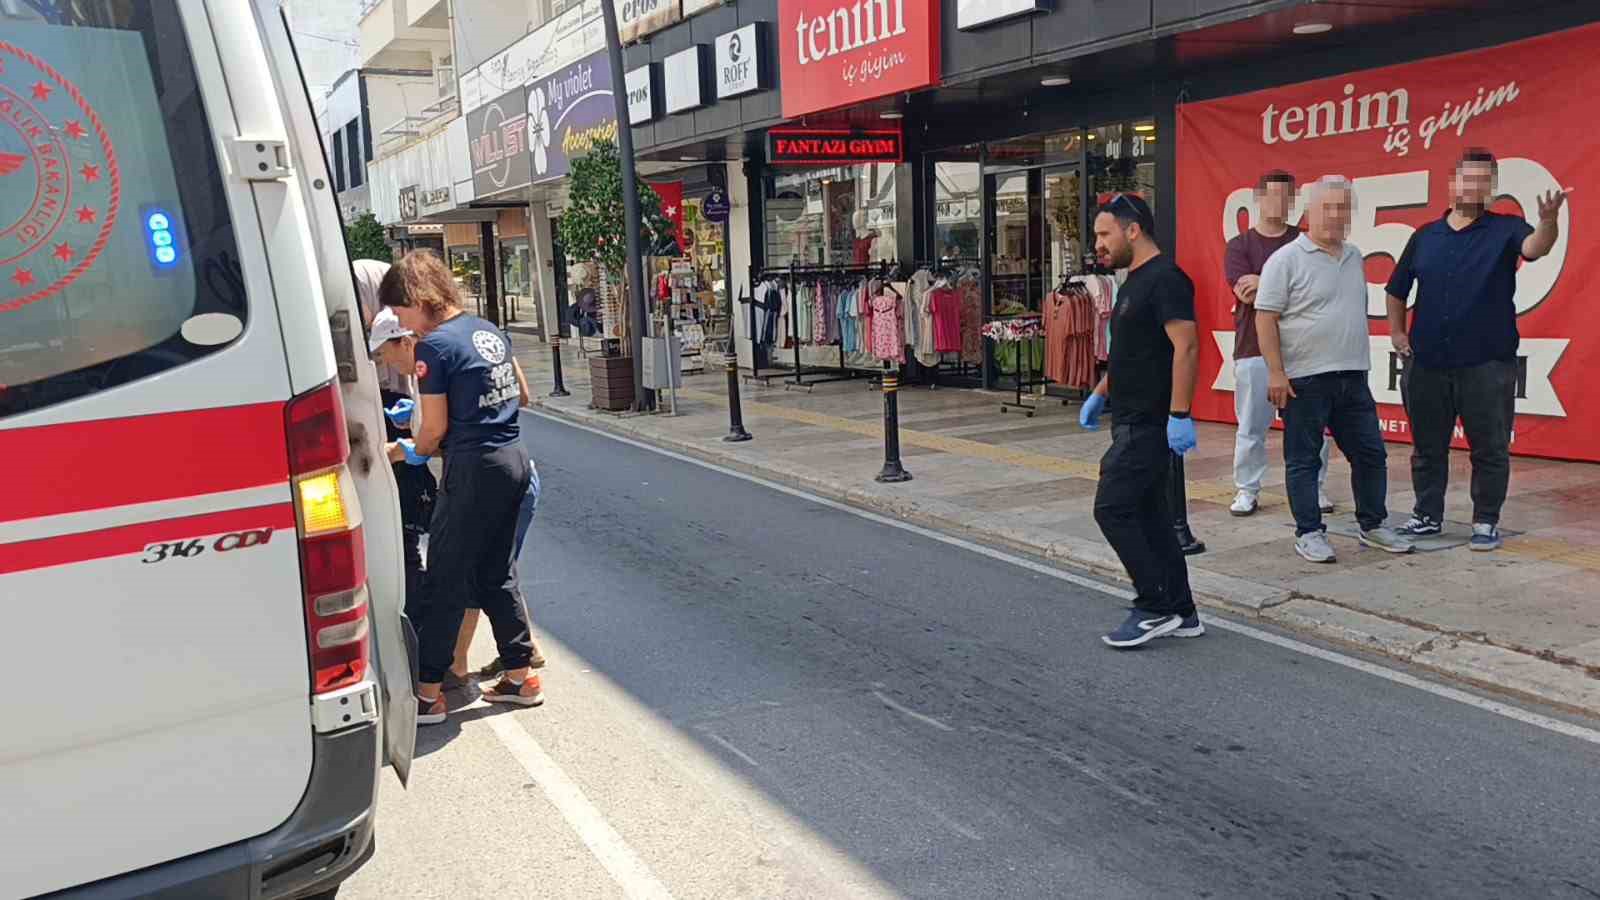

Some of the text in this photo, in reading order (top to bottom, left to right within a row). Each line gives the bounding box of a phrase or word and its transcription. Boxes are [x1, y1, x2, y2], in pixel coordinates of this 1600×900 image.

[547, 75, 564, 111] My
[565, 63, 593, 97] violet
[860, 47, 906, 82] giyim
[1260, 83, 1410, 145] tenim
[1383, 81, 1520, 156] iç giyim
[141, 527, 274, 564] 316 CDI
